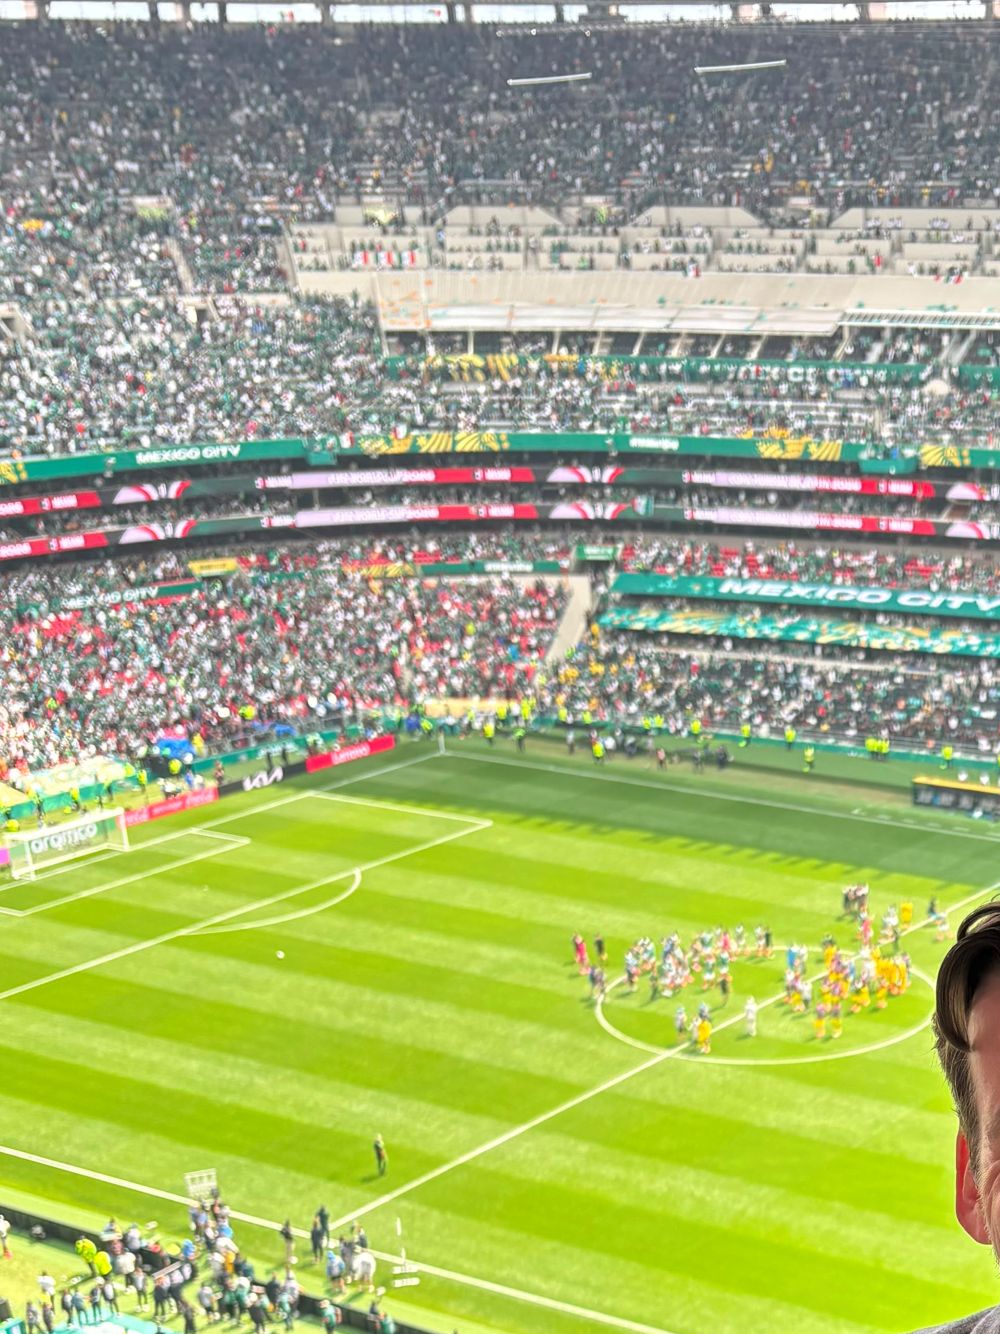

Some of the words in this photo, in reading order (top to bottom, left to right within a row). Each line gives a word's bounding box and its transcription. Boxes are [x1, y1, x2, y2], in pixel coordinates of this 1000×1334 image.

[135, 446, 201, 465] MEXICO
[202, 444, 241, 459] CITY
[718, 578, 893, 604] MEXICO
[31, 823, 98, 854] aramco
